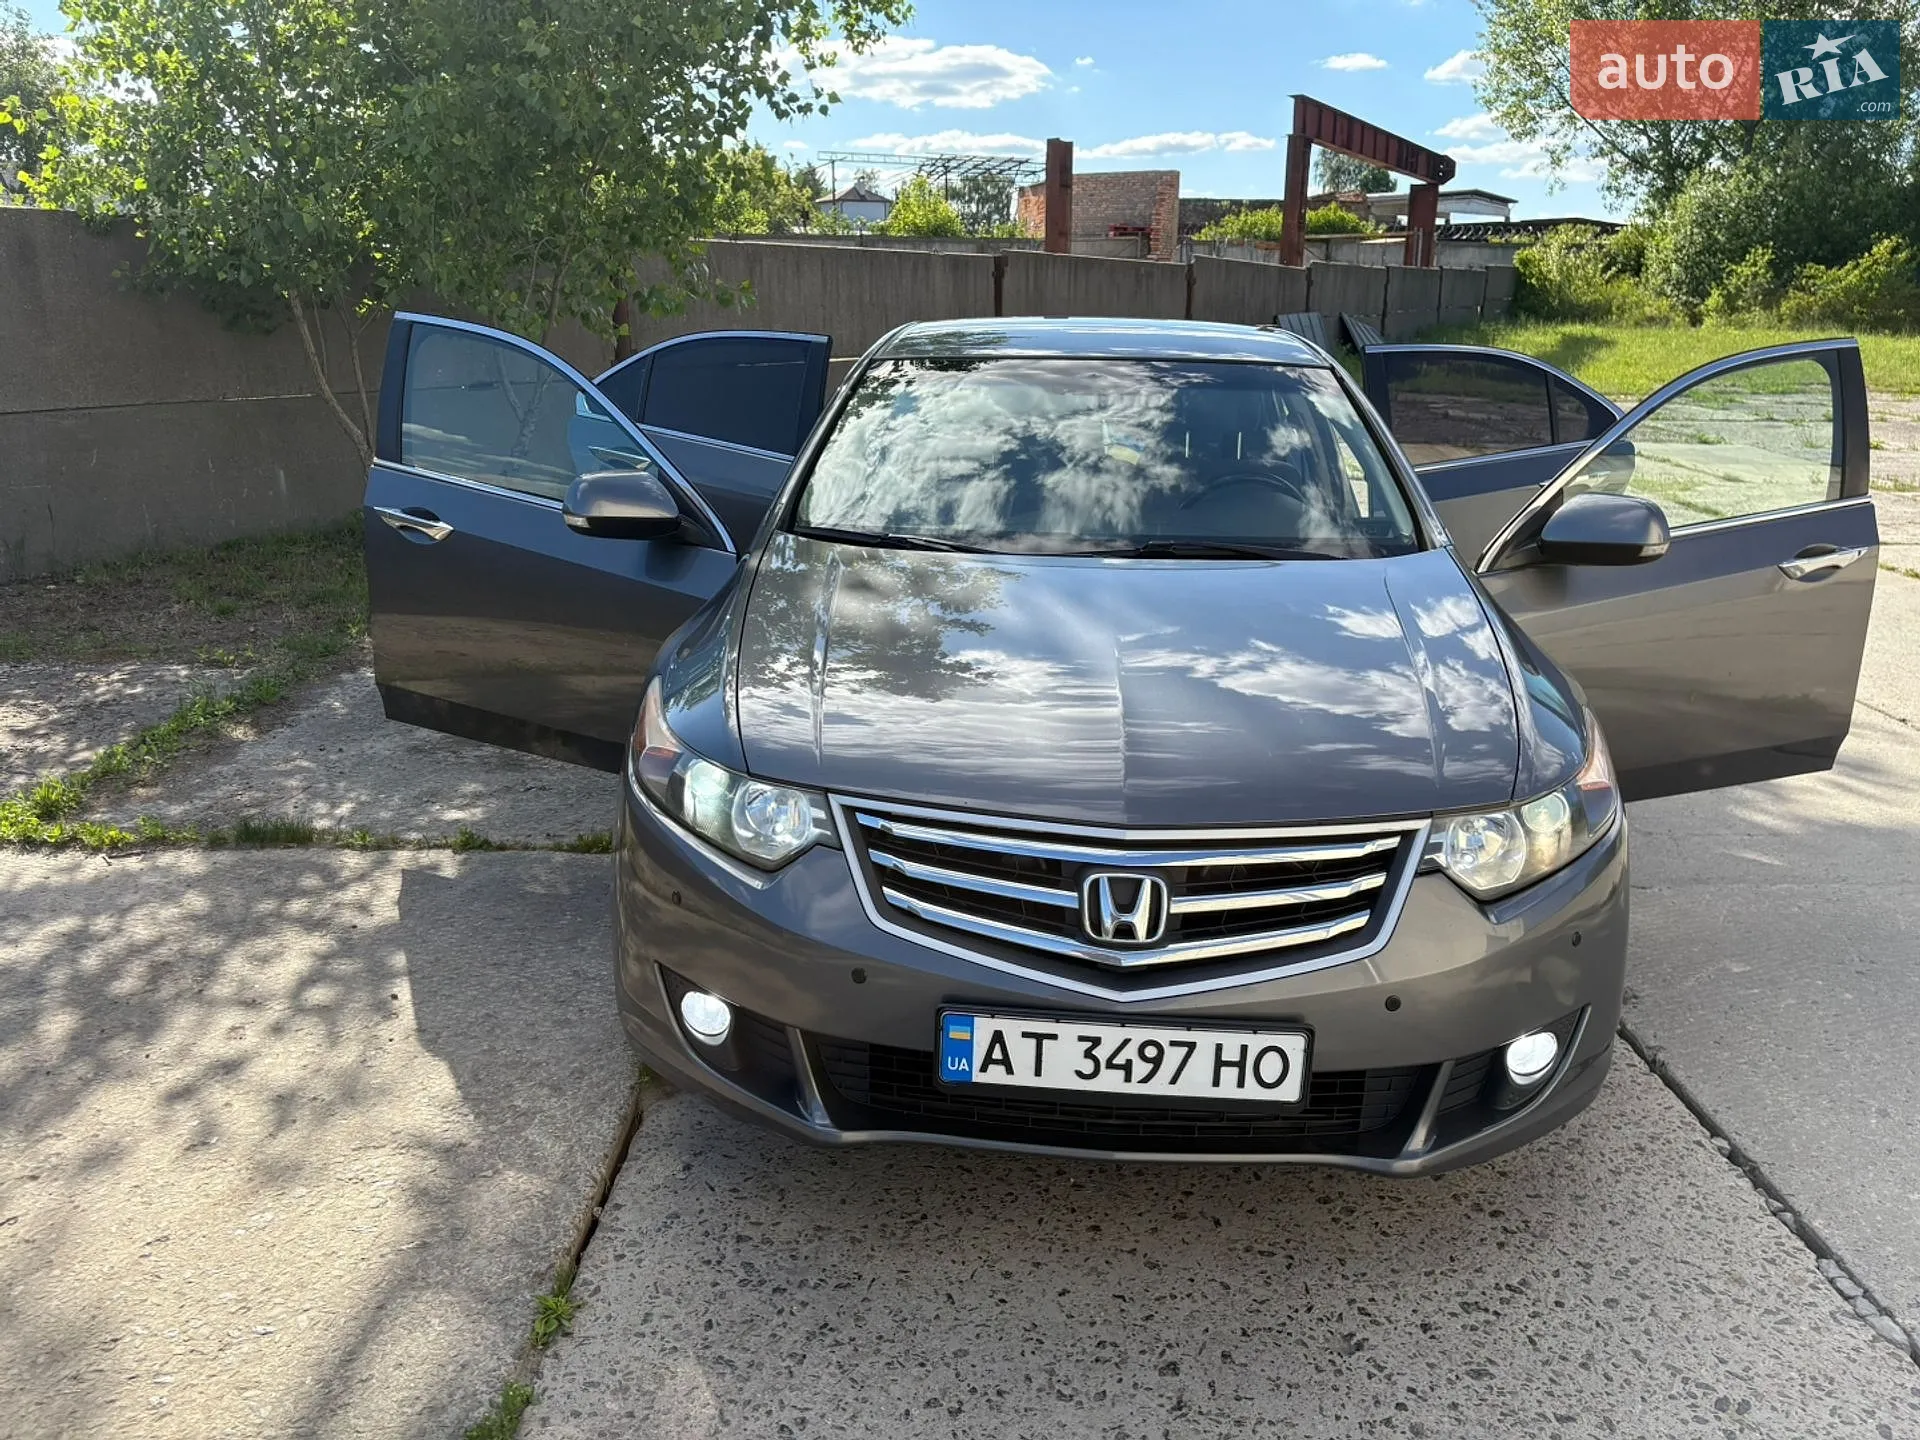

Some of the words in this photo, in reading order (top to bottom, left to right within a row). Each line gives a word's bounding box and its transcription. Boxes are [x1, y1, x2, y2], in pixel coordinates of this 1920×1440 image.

[947, 1057, 970, 1072] UA
[979, 1029, 1058, 1077] AT
[1074, 1035, 1197, 1085] 3497
[1212, 1043, 1290, 1089] HO
